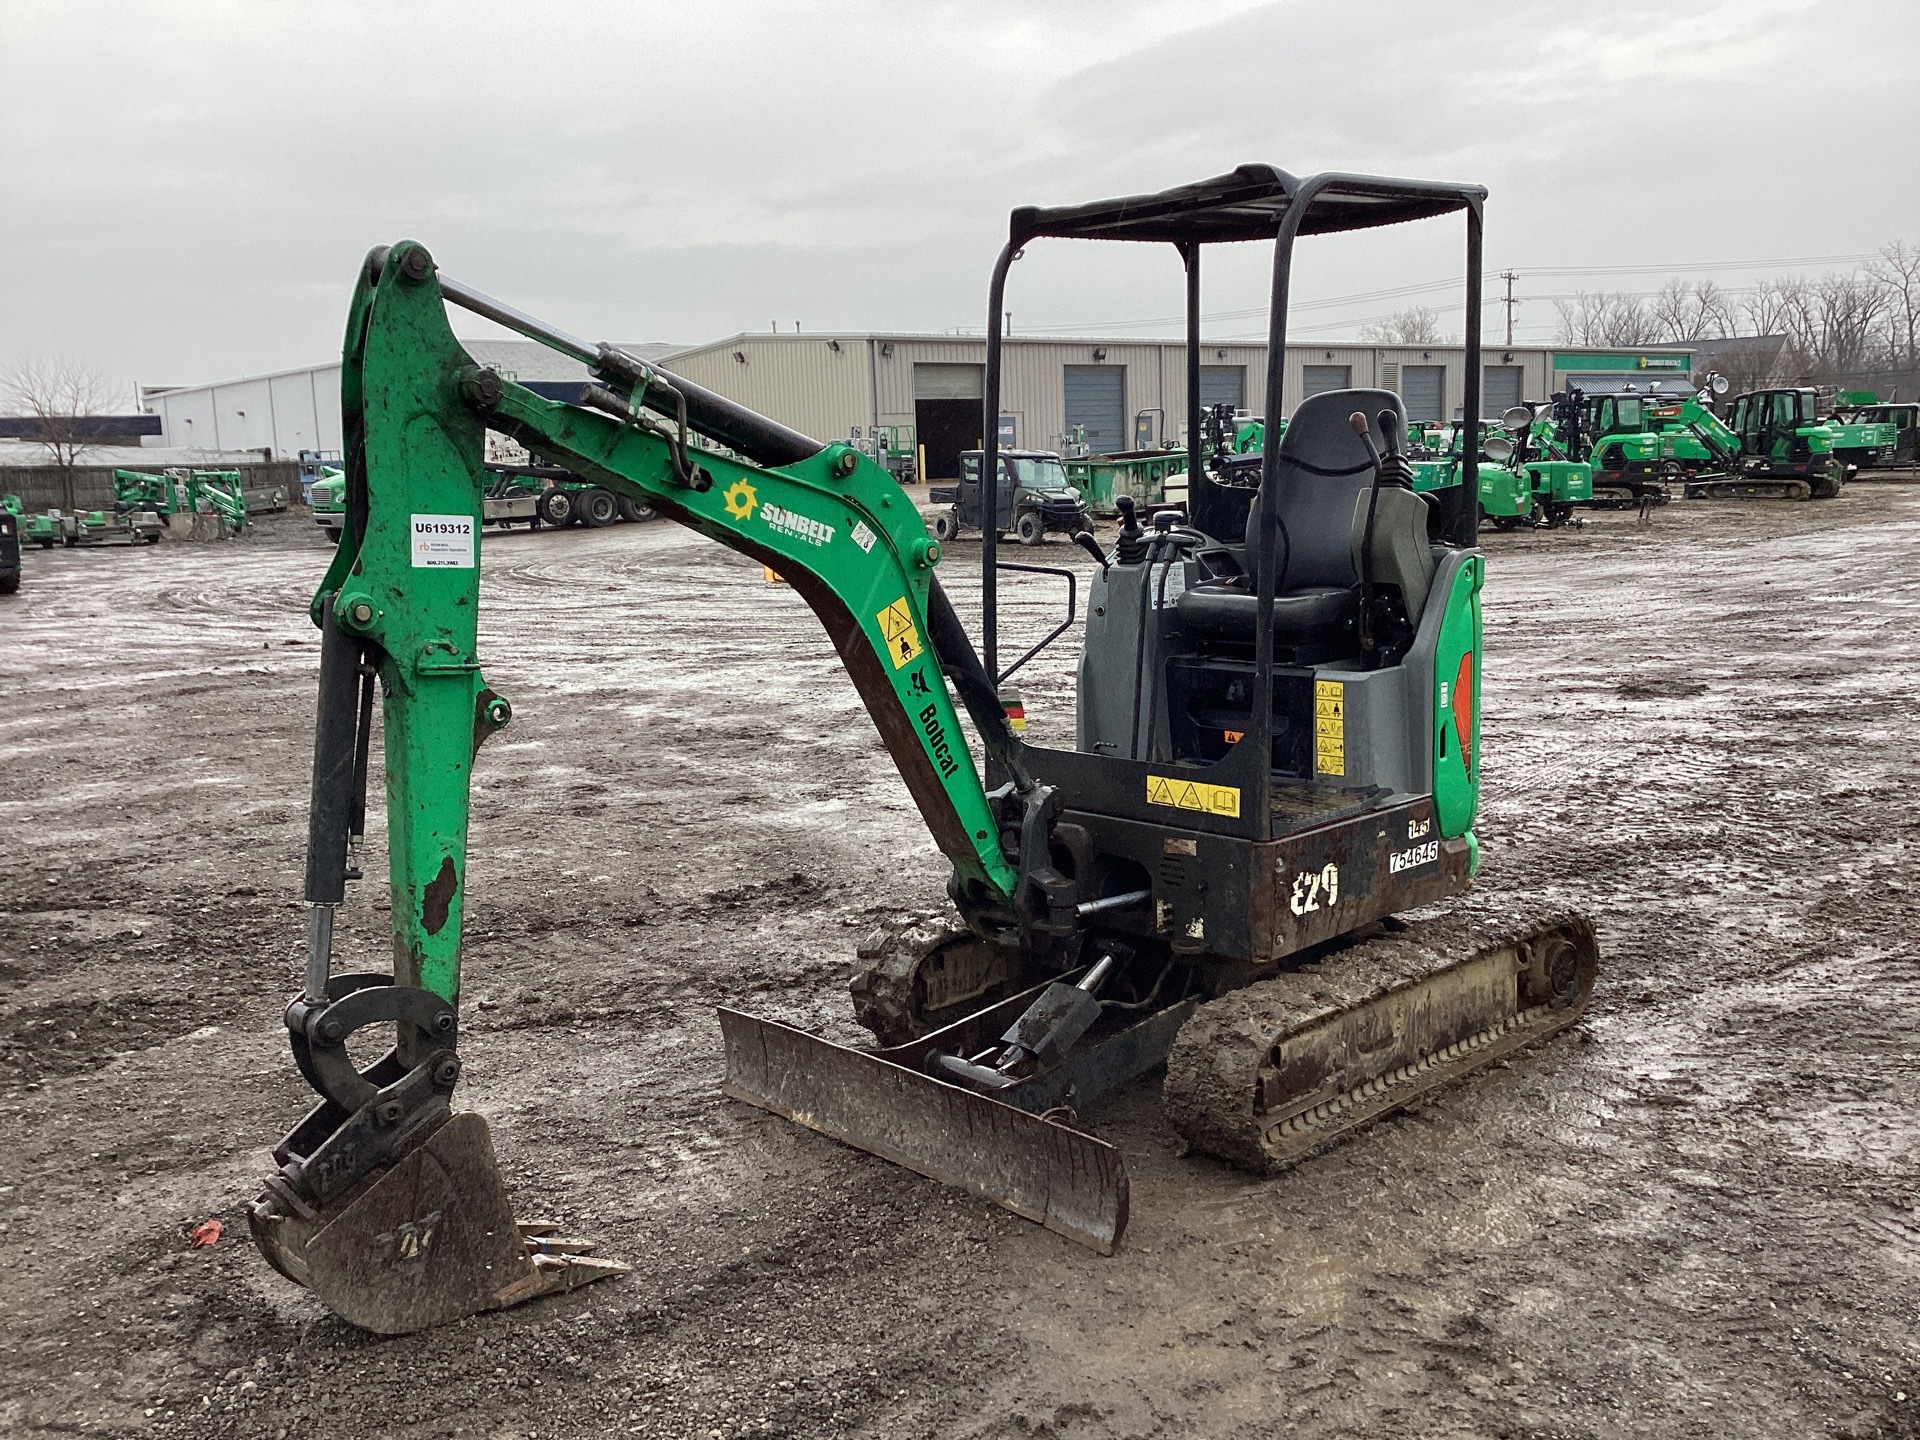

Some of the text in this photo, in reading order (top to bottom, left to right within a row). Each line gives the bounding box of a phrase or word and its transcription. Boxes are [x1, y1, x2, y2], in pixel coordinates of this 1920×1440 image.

[415, 523, 470, 534] U619312
[760, 502, 836, 543] SUNBELT
[918, 702, 960, 780] Bobcat
[1391, 842, 1437, 872] 754645
